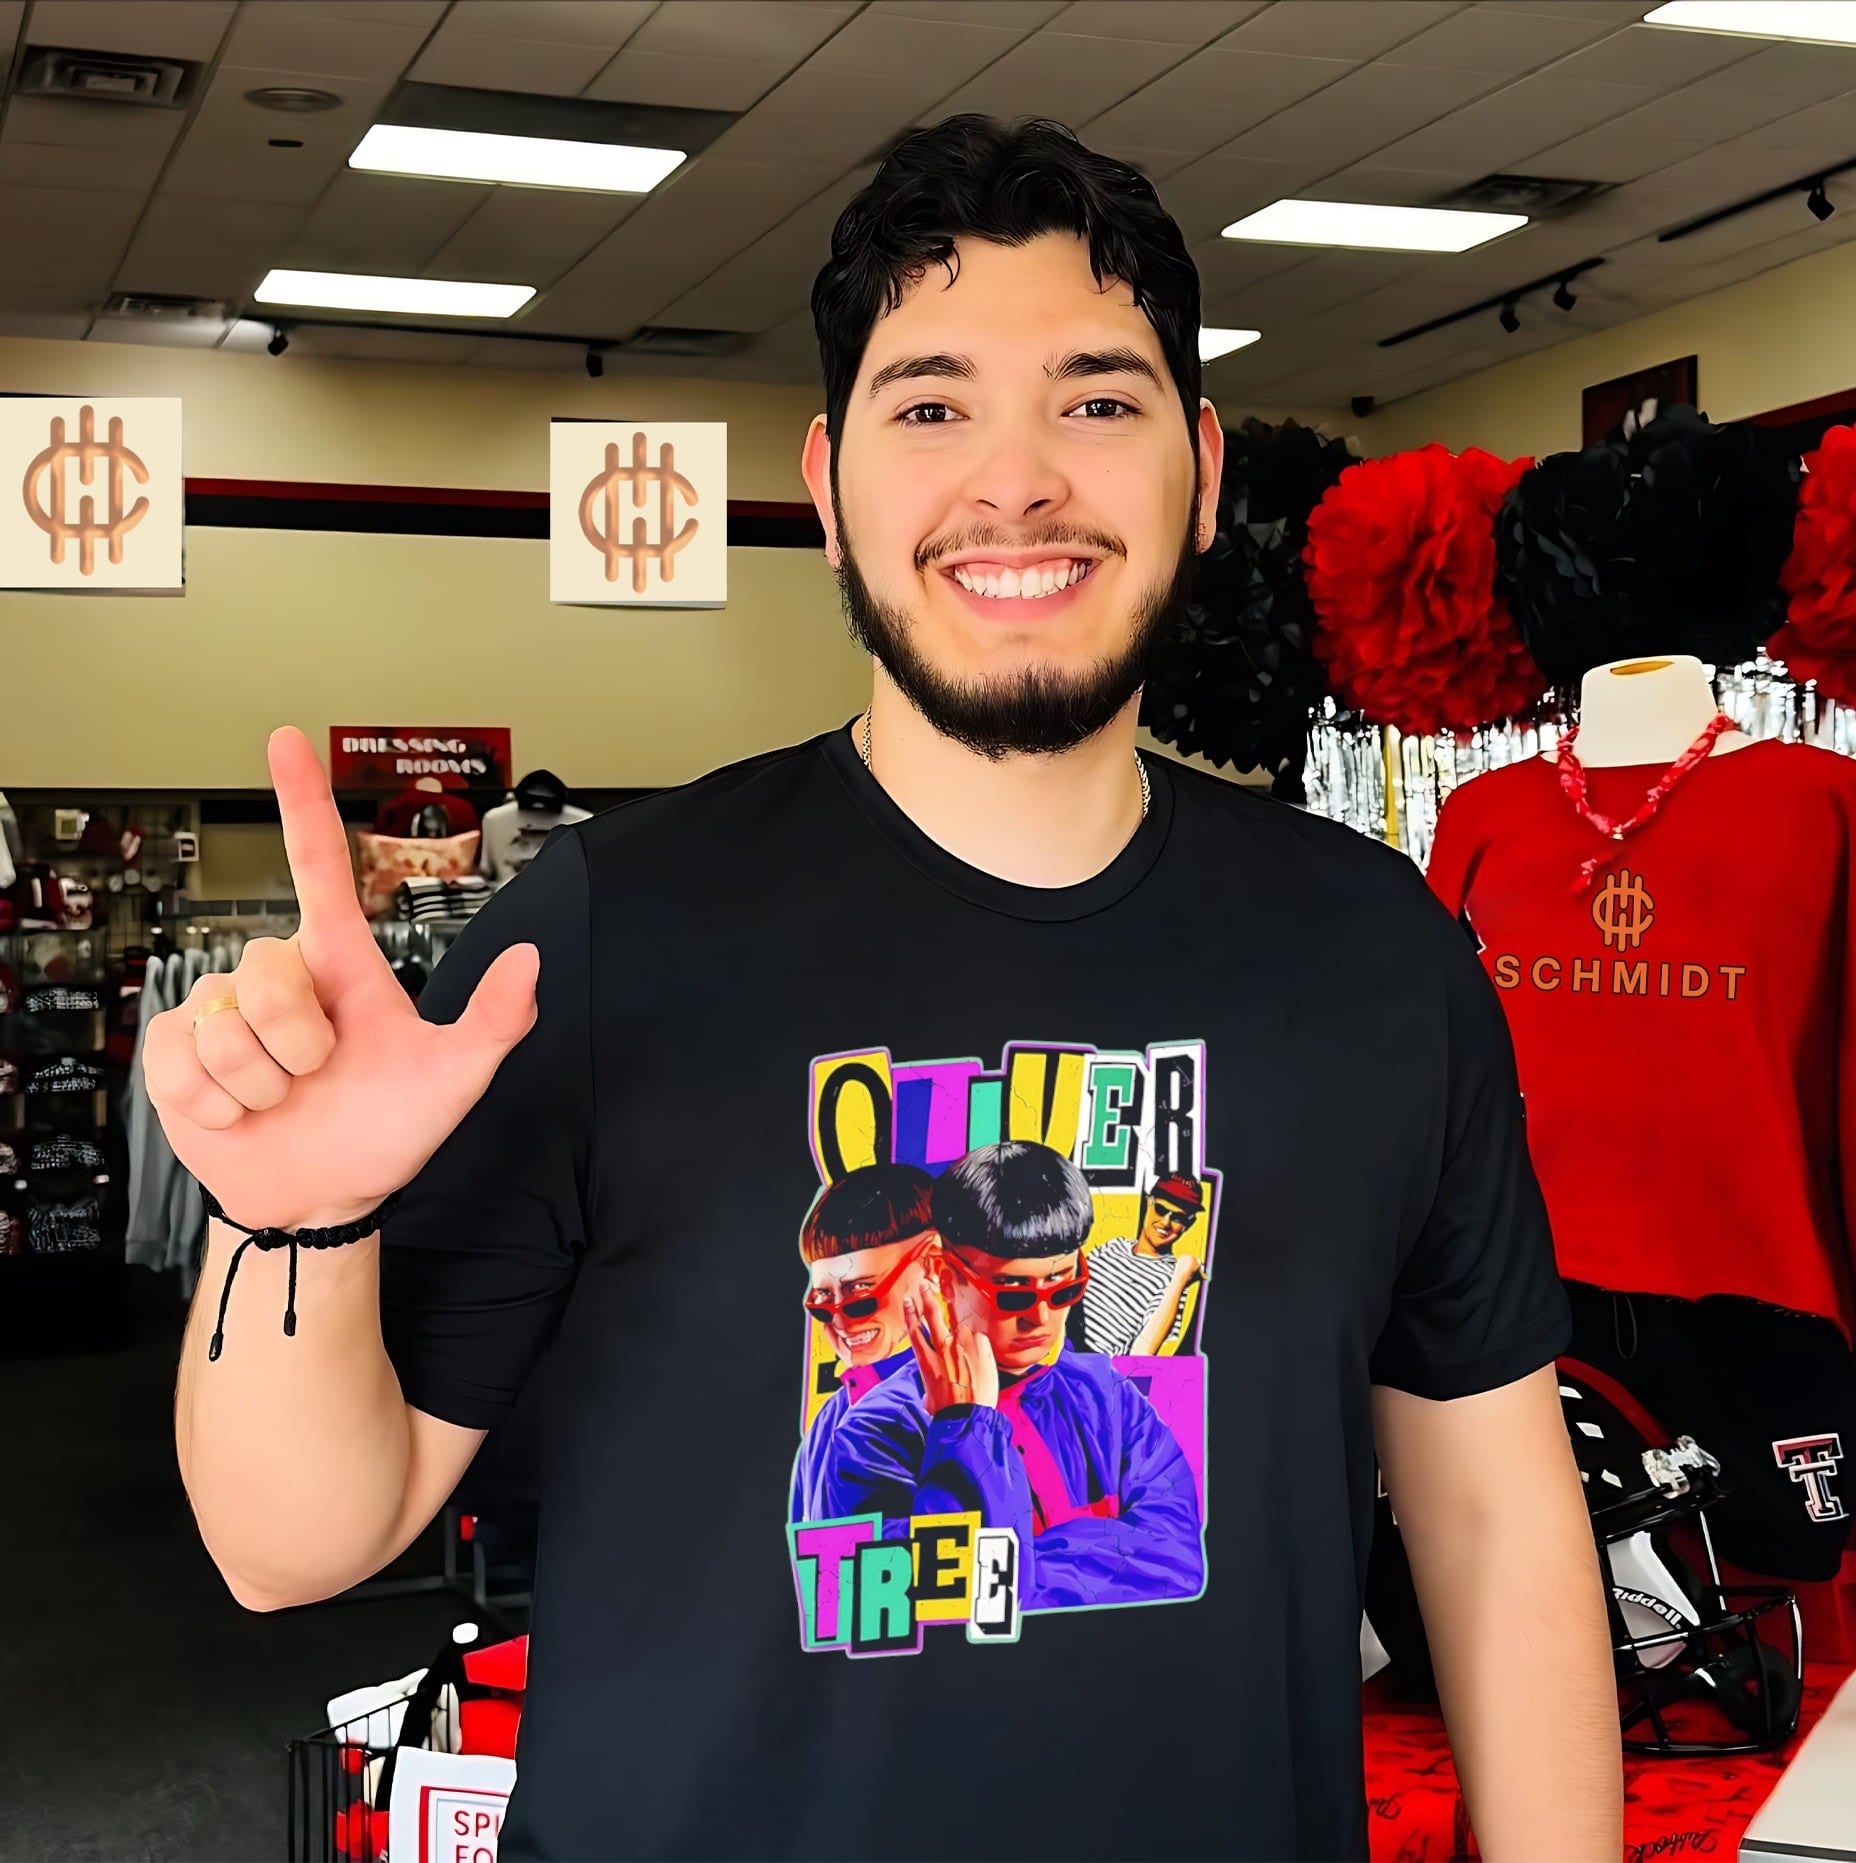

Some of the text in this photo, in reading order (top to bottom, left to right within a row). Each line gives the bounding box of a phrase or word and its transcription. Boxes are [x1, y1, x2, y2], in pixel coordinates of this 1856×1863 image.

[1494, 954, 1747, 1000] SCHMIDT
[817, 1048, 1198, 1188] OLIVER
[796, 1519, 1017, 1643] TREE
